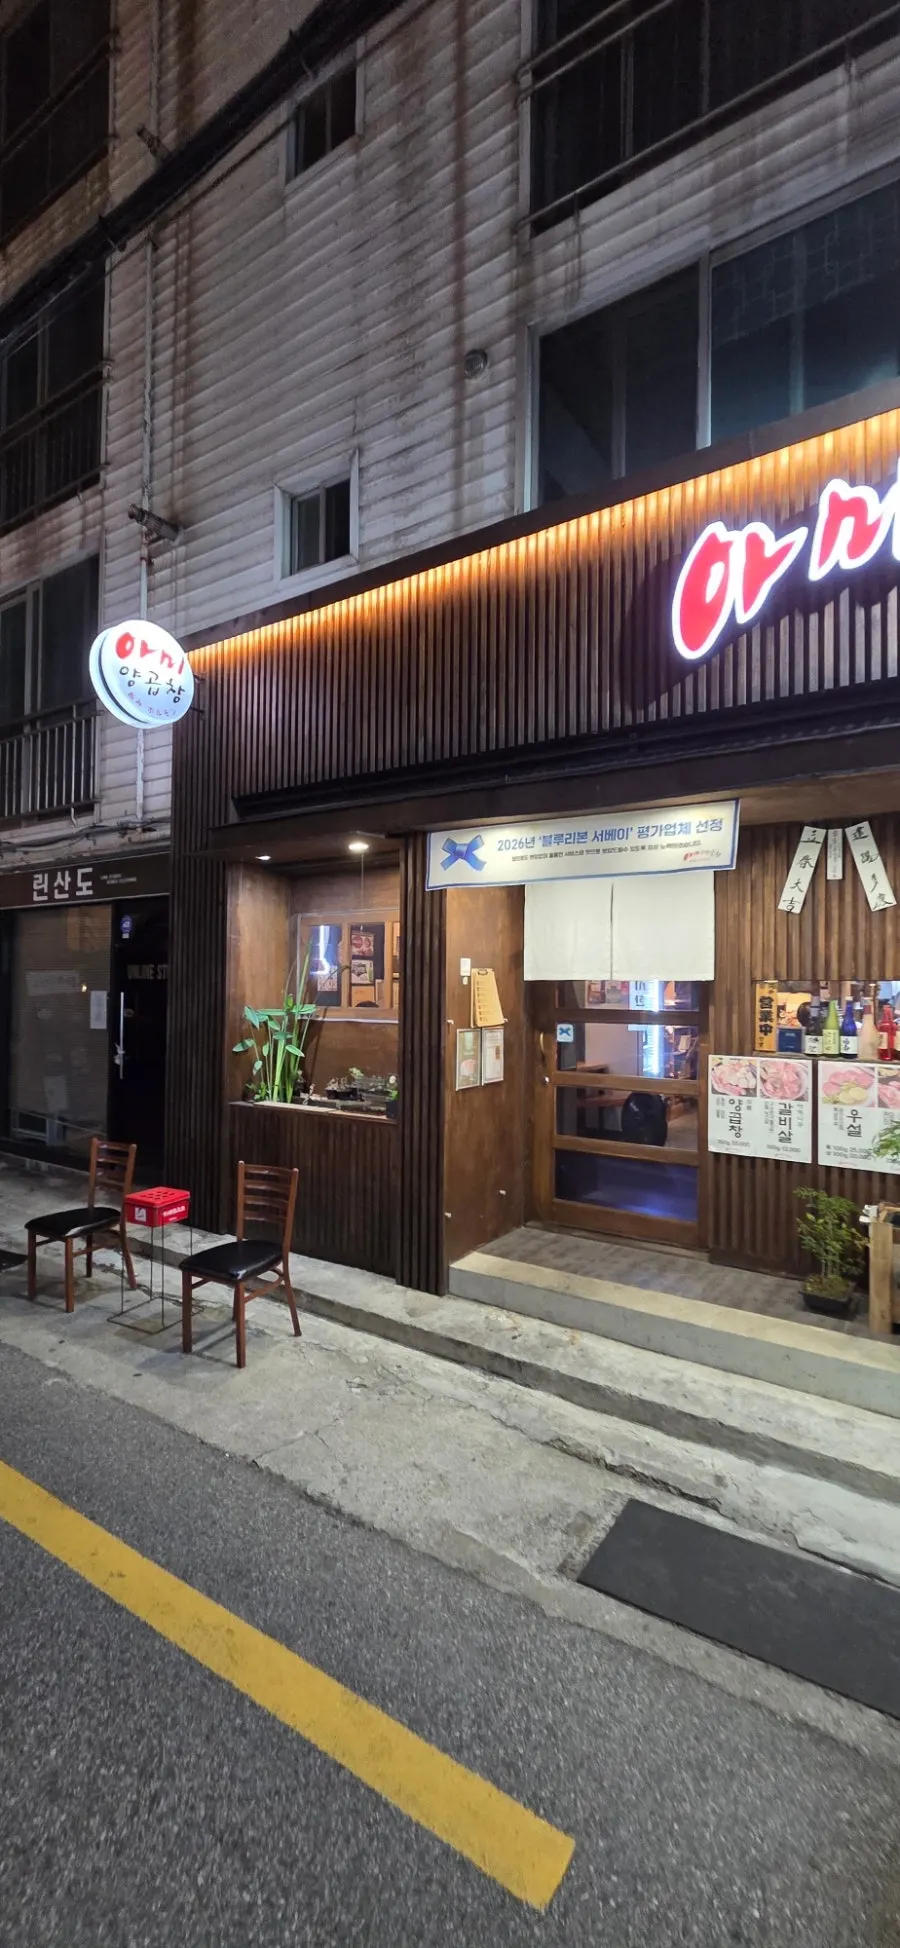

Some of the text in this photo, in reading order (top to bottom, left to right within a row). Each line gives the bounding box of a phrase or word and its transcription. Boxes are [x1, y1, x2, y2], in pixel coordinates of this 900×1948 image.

[120, 666, 186, 703] 양곱창
[497, 837, 536, 852] 2026년
[637, 822, 692, 839] 평가업체
[696, 818, 723, 834] 선정
[32, 867, 94, 902] 린산도
[729, 1098, 743, 1139] 양곱창
[778, 1102, 793, 1144] 갈비살
[847, 1109, 862, 1138] 우설
